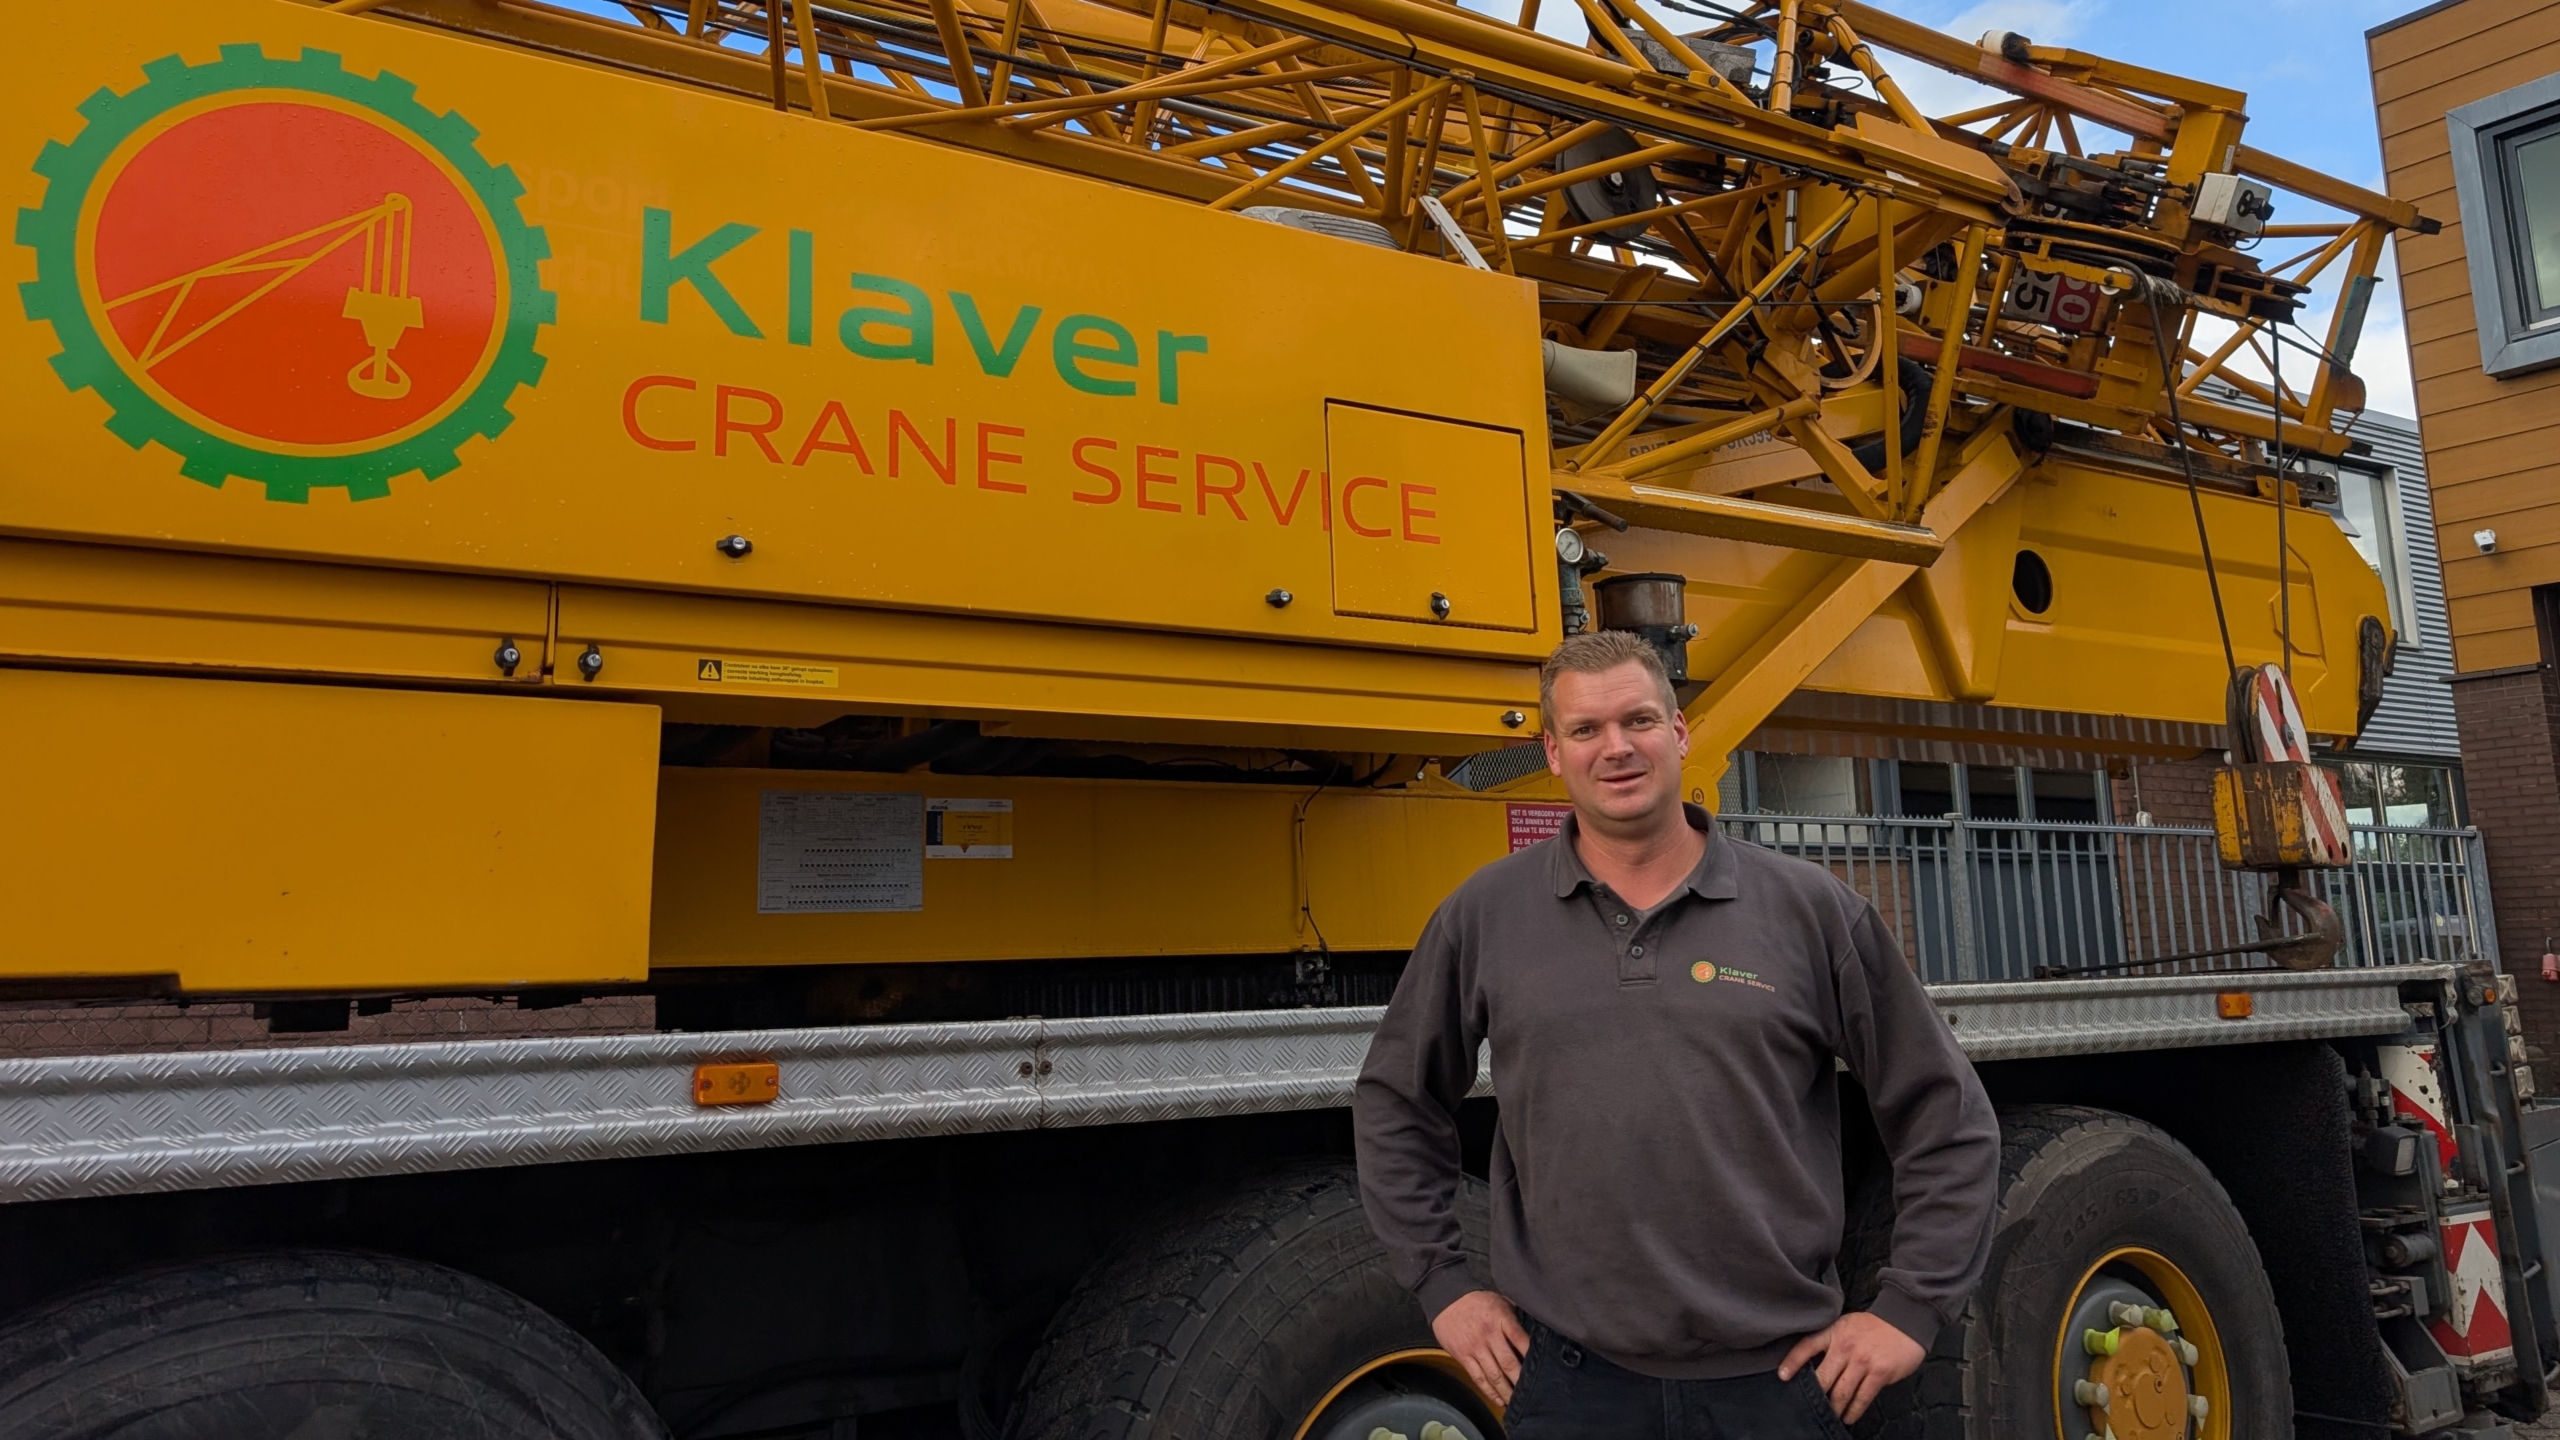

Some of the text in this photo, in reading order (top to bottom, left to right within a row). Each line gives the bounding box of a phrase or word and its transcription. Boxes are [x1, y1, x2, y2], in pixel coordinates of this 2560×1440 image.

[640, 206, 1208, 404] Klaver
[622, 375, 1441, 545] CRANE SERVICE
[1538, 827, 1560, 835] BEVINDE
[1720, 967, 1758, 979] Klaver
[1719, 975, 1775, 992] CRANE SERVICE
